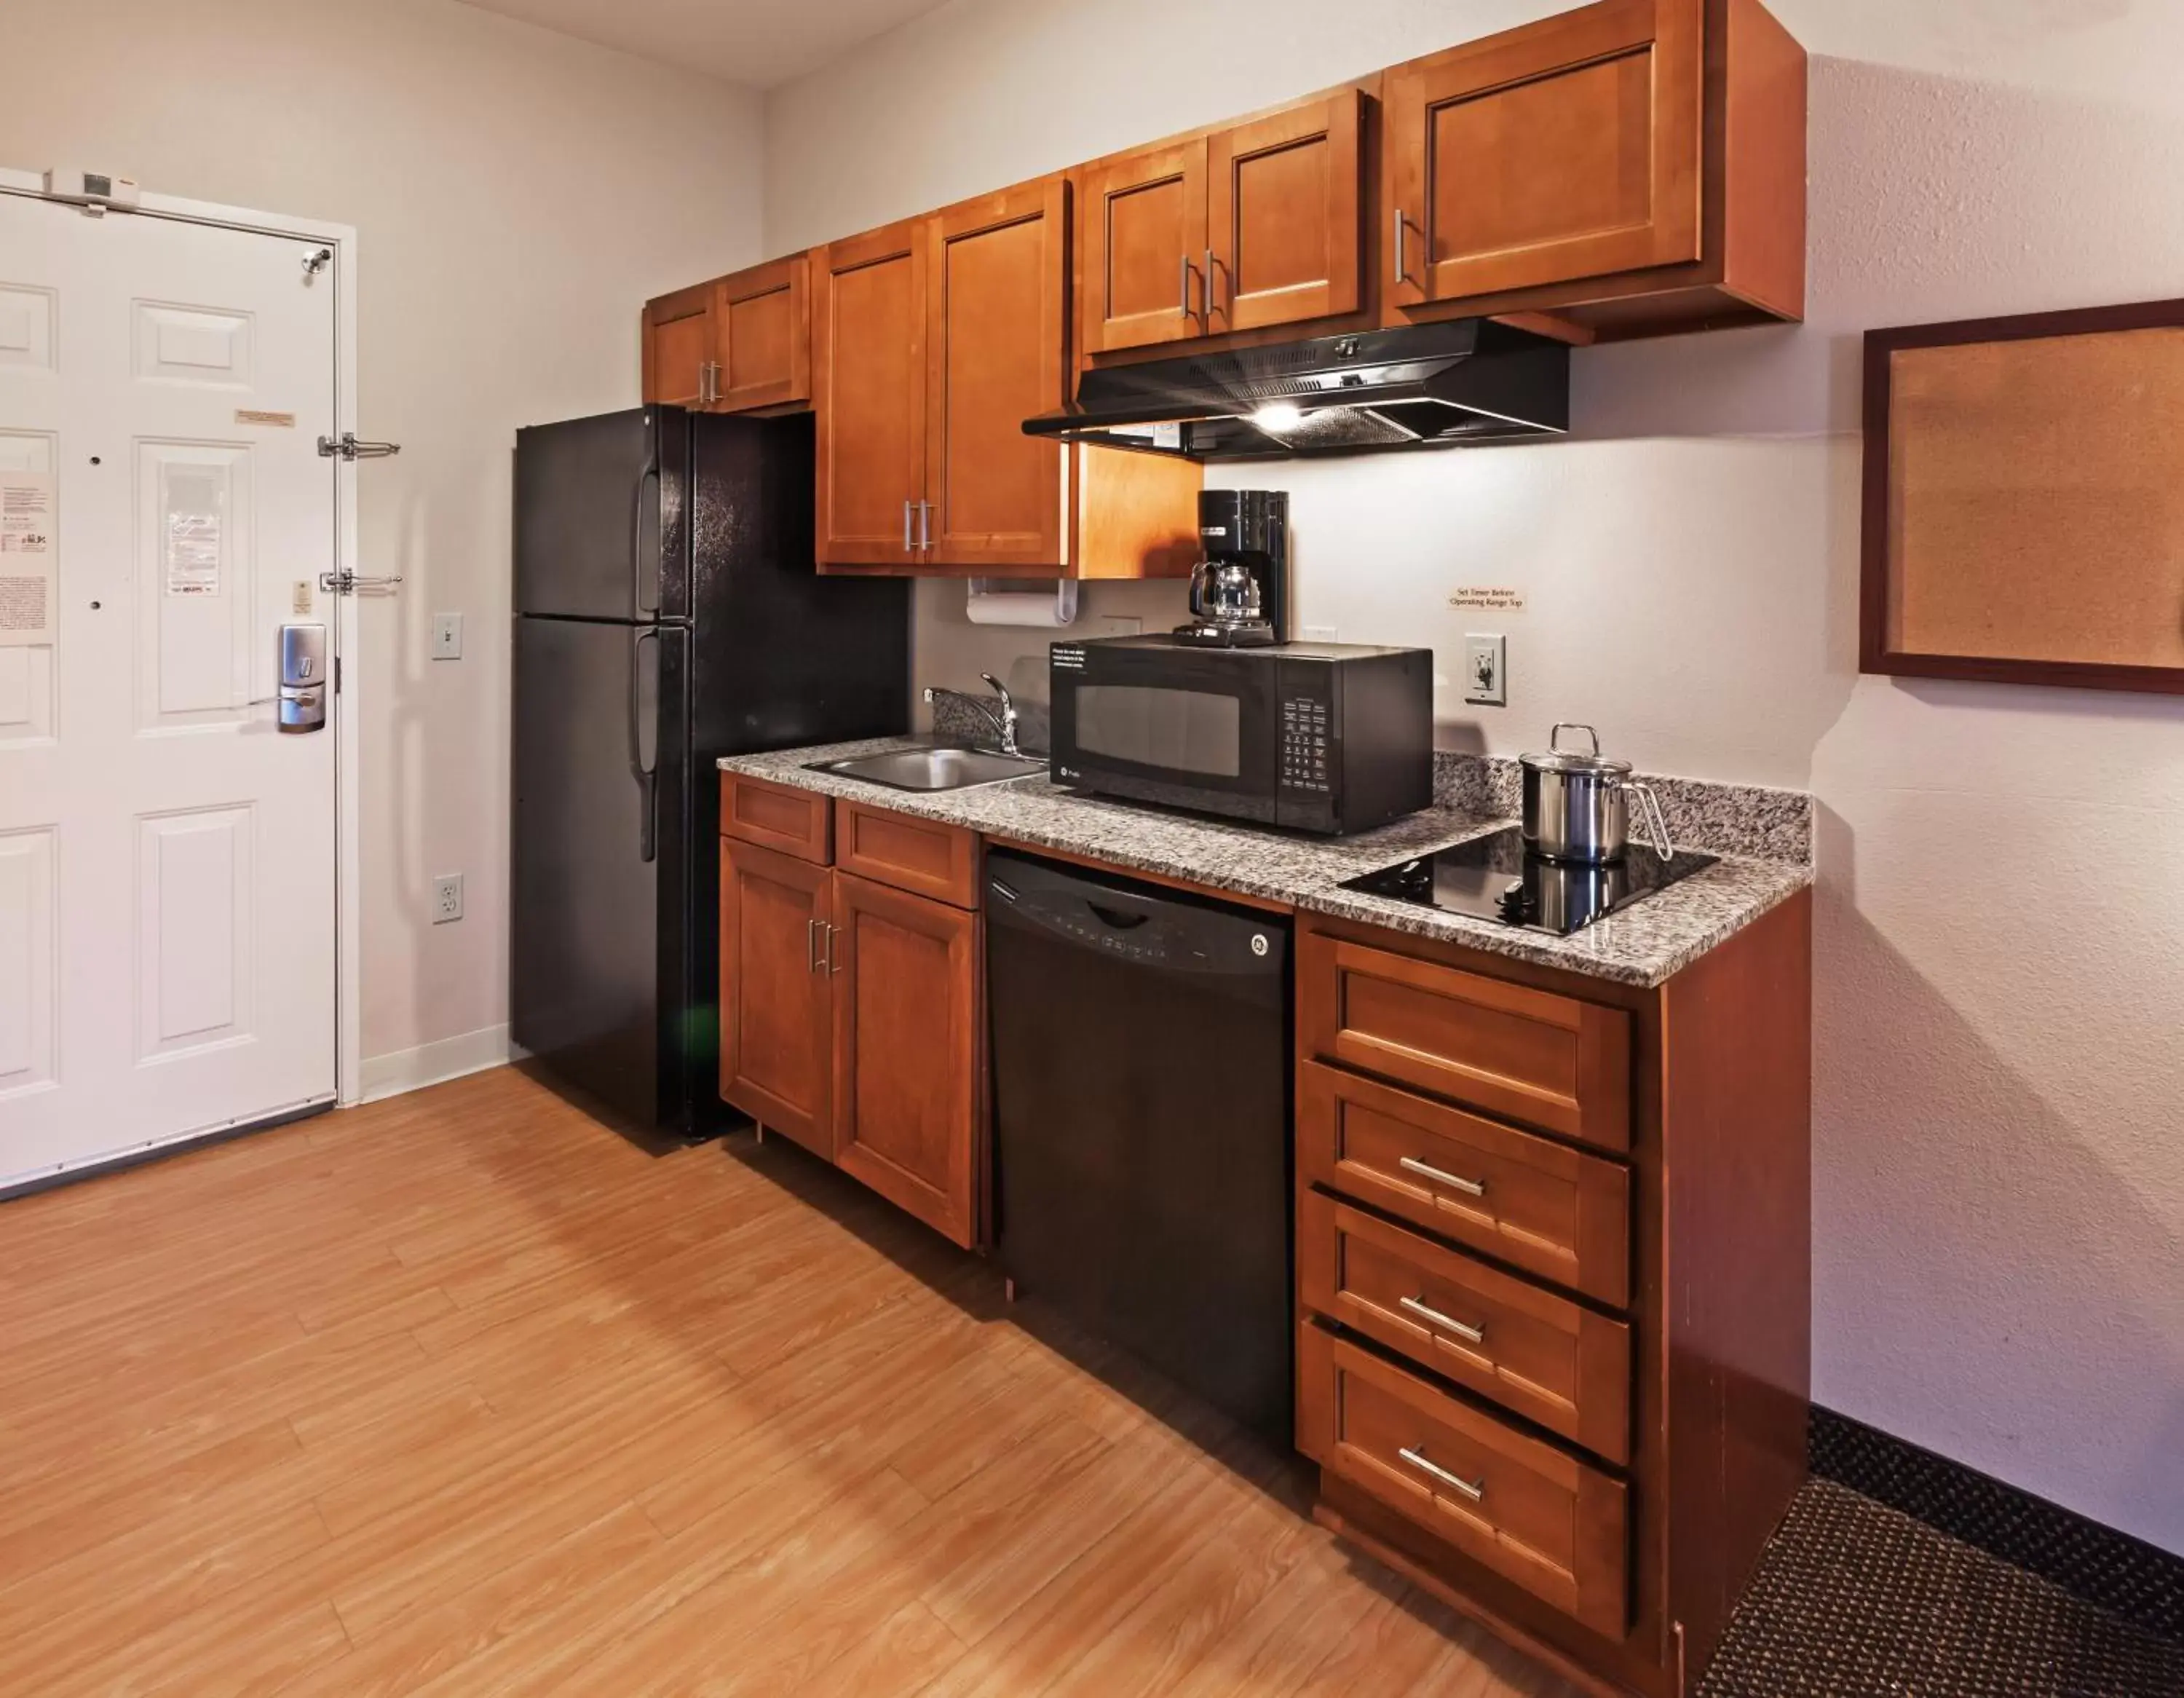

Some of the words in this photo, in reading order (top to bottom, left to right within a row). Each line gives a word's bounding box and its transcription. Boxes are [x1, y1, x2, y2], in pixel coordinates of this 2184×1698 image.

[1457, 588, 1468, 596] Set
[1449, 598, 1484, 608] Operating
[1486, 599, 1508, 608] Range
